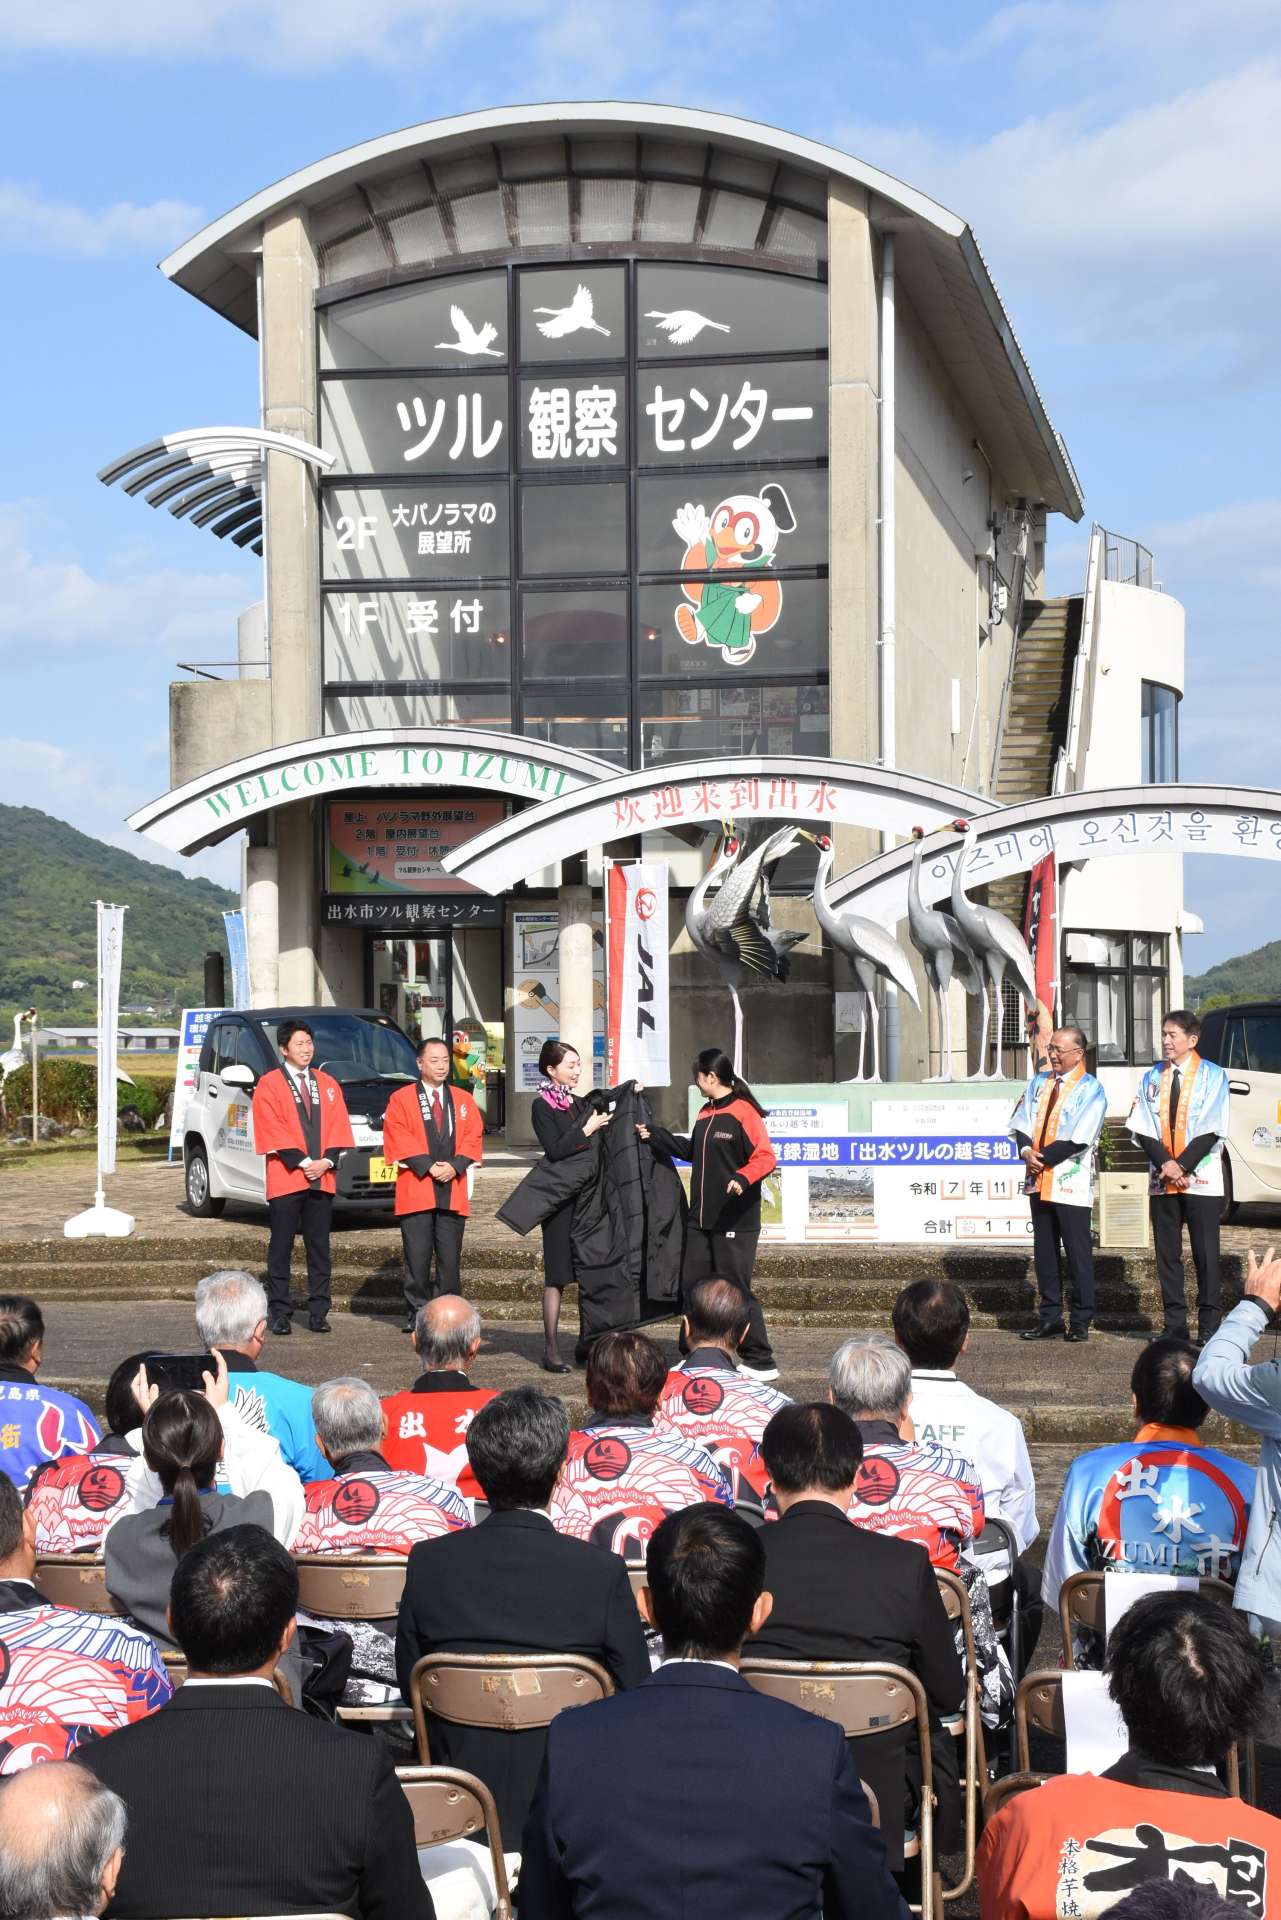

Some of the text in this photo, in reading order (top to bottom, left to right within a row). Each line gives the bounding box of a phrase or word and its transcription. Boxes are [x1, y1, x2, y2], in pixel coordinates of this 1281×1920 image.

[397, 381, 814, 462] ツル 観察 センター
[392, 502, 497, 528] 大パノラマの
[336, 517, 378, 550] 2F
[417, 530, 472, 555] 展望所
[339, 602, 379, 635] 1F
[204, 748, 569, 820] WELCOME TO IZUMI
[613, 777, 838, 830] 欢迎来到出水
[1079, 811, 1213, 847] 오신것을
[428, 845, 458, 857] 休憩
[327, 903, 496, 921] 出水市ツル観察センター
[637, 933, 656, 1040] JAL
[923, 1220, 953, 1234] 合計
[913, 1423, 966, 1442] AFF
[1099, 1537, 1181, 1567] ZUMI
